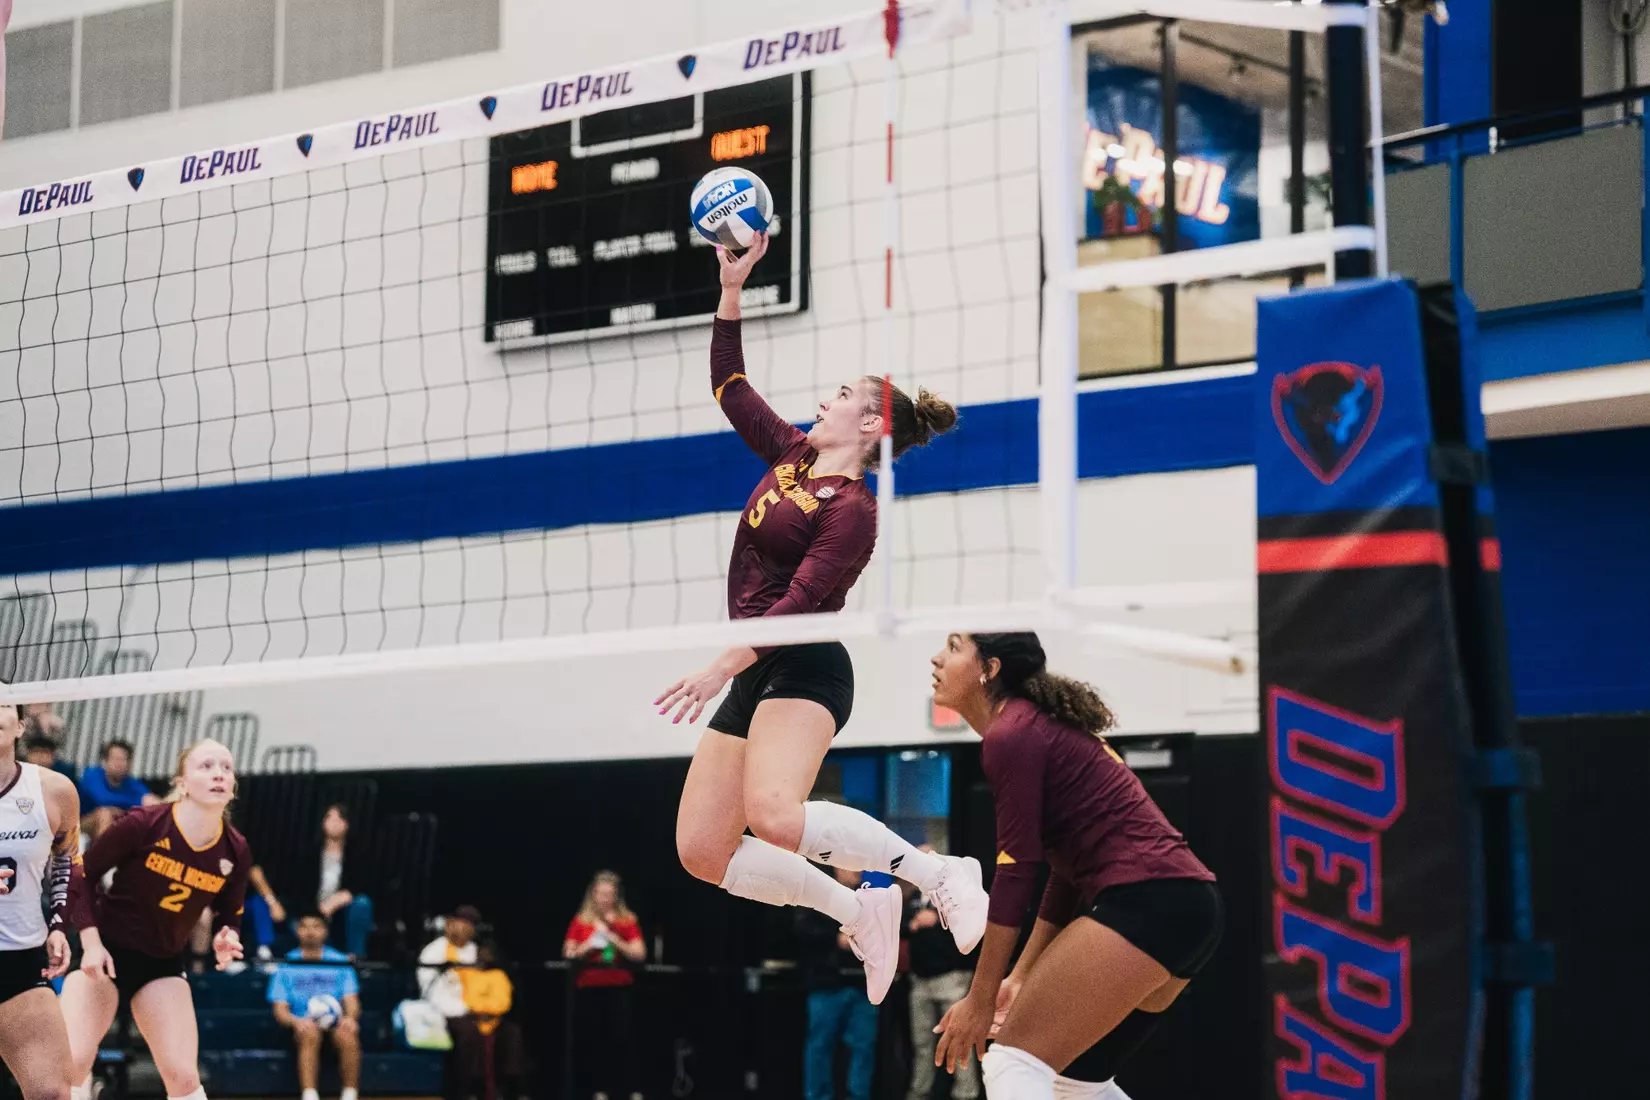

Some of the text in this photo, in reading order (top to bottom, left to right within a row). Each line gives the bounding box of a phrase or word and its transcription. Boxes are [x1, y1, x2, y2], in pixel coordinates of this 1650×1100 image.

[708, 193, 748, 224] molten
[748, 488, 781, 529] 5
[159, 883, 192, 913] 2
